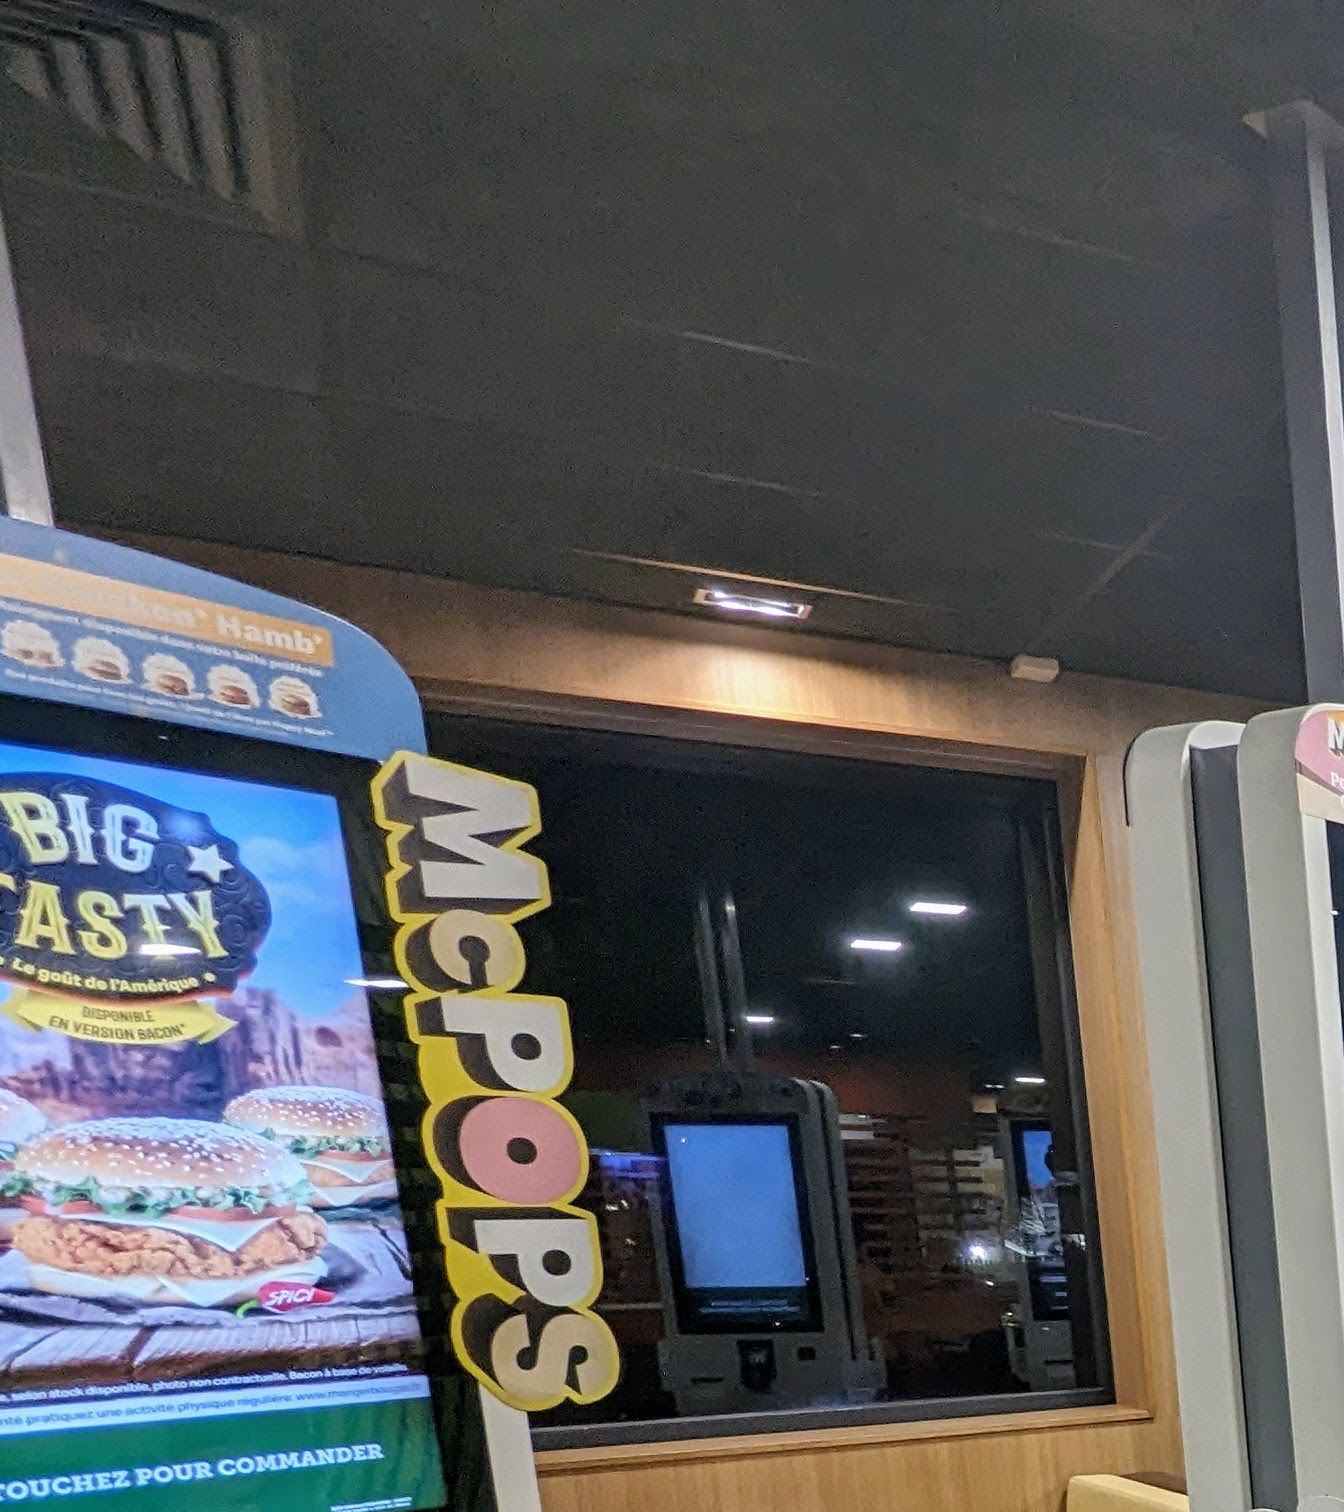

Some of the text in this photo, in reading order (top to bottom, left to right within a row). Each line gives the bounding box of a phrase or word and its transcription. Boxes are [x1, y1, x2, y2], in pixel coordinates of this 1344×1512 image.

[0, 792, 160, 873] BIG
[12, 957, 199, 994] Le goût de l'Amérique
[50, 1015, 71, 1032] EN
[74, 1021, 135, 1041] VERSION
[82, 1006, 155, 1023] DISPONIBLE
[385, 757, 616, 1403] McPOPS
[49, 1386, 84, 1398] stock
[85, 1382, 151, 1396] disponible,
[153, 1378, 188, 1392] photo
[189, 1378, 211, 1388] non
[212, 1373, 289, 1387] contractuelle.
[290, 1369, 323, 1381] Bacon
[332, 1366, 358, 1377] base
[359, 1365, 372, 1375] de
[96, 1408, 123, 1419] une
[134, 1461, 214, 1487] POUR
[216, 1442, 386, 1477] COMMANDER
